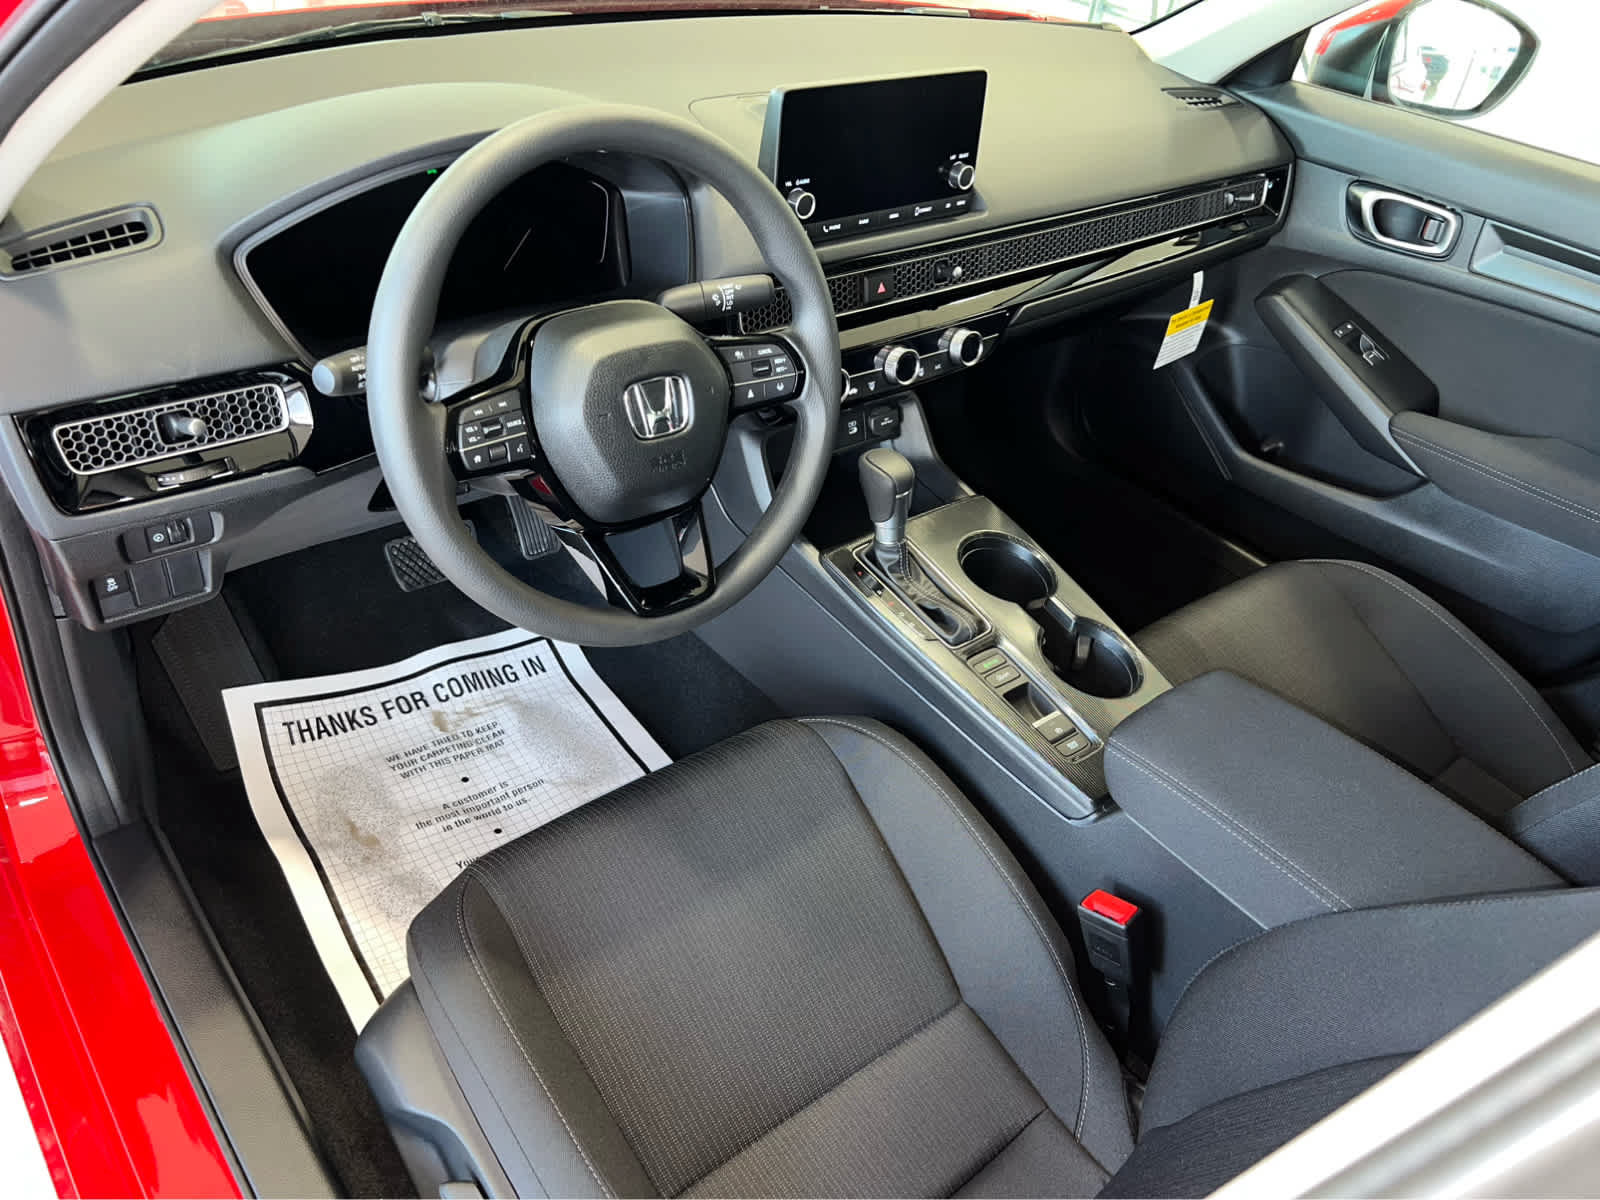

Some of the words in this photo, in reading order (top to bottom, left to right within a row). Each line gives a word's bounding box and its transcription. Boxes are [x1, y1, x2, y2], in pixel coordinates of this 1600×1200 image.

[282, 706, 378, 746] THANKS
[381, 691, 430, 720] FOR
[432, 664, 520, 703] COMING
[521, 655, 547, 677] IN
[385, 754, 403, 763] WE
[404, 743, 431, 758] HAVE
[431, 734, 460, 748] TRIED
[461, 729, 474, 738] TO
[475, 721, 498, 734] KEEP
[389, 757, 418, 772] YOUR
[419, 740, 474, 762] CARPETING
[475, 728, 505, 745] CLEAN
[400, 764, 427, 779] WITH
[428, 756, 452, 769] THIS
[453, 747, 484, 762] PAPER
[485, 739, 505, 752] MAT
[416, 818, 432, 830] the
[434, 809, 460, 823] most
[462, 791, 511, 815] important
[511, 778, 545, 798] person
[442, 824, 454, 832] in
[454, 817, 472, 828] the
[473, 806, 502, 822] world
[502, 801, 514, 812] to
[516, 796, 528, 806] us
[452, 786, 497, 806] customer
[499, 780, 509, 789] is
